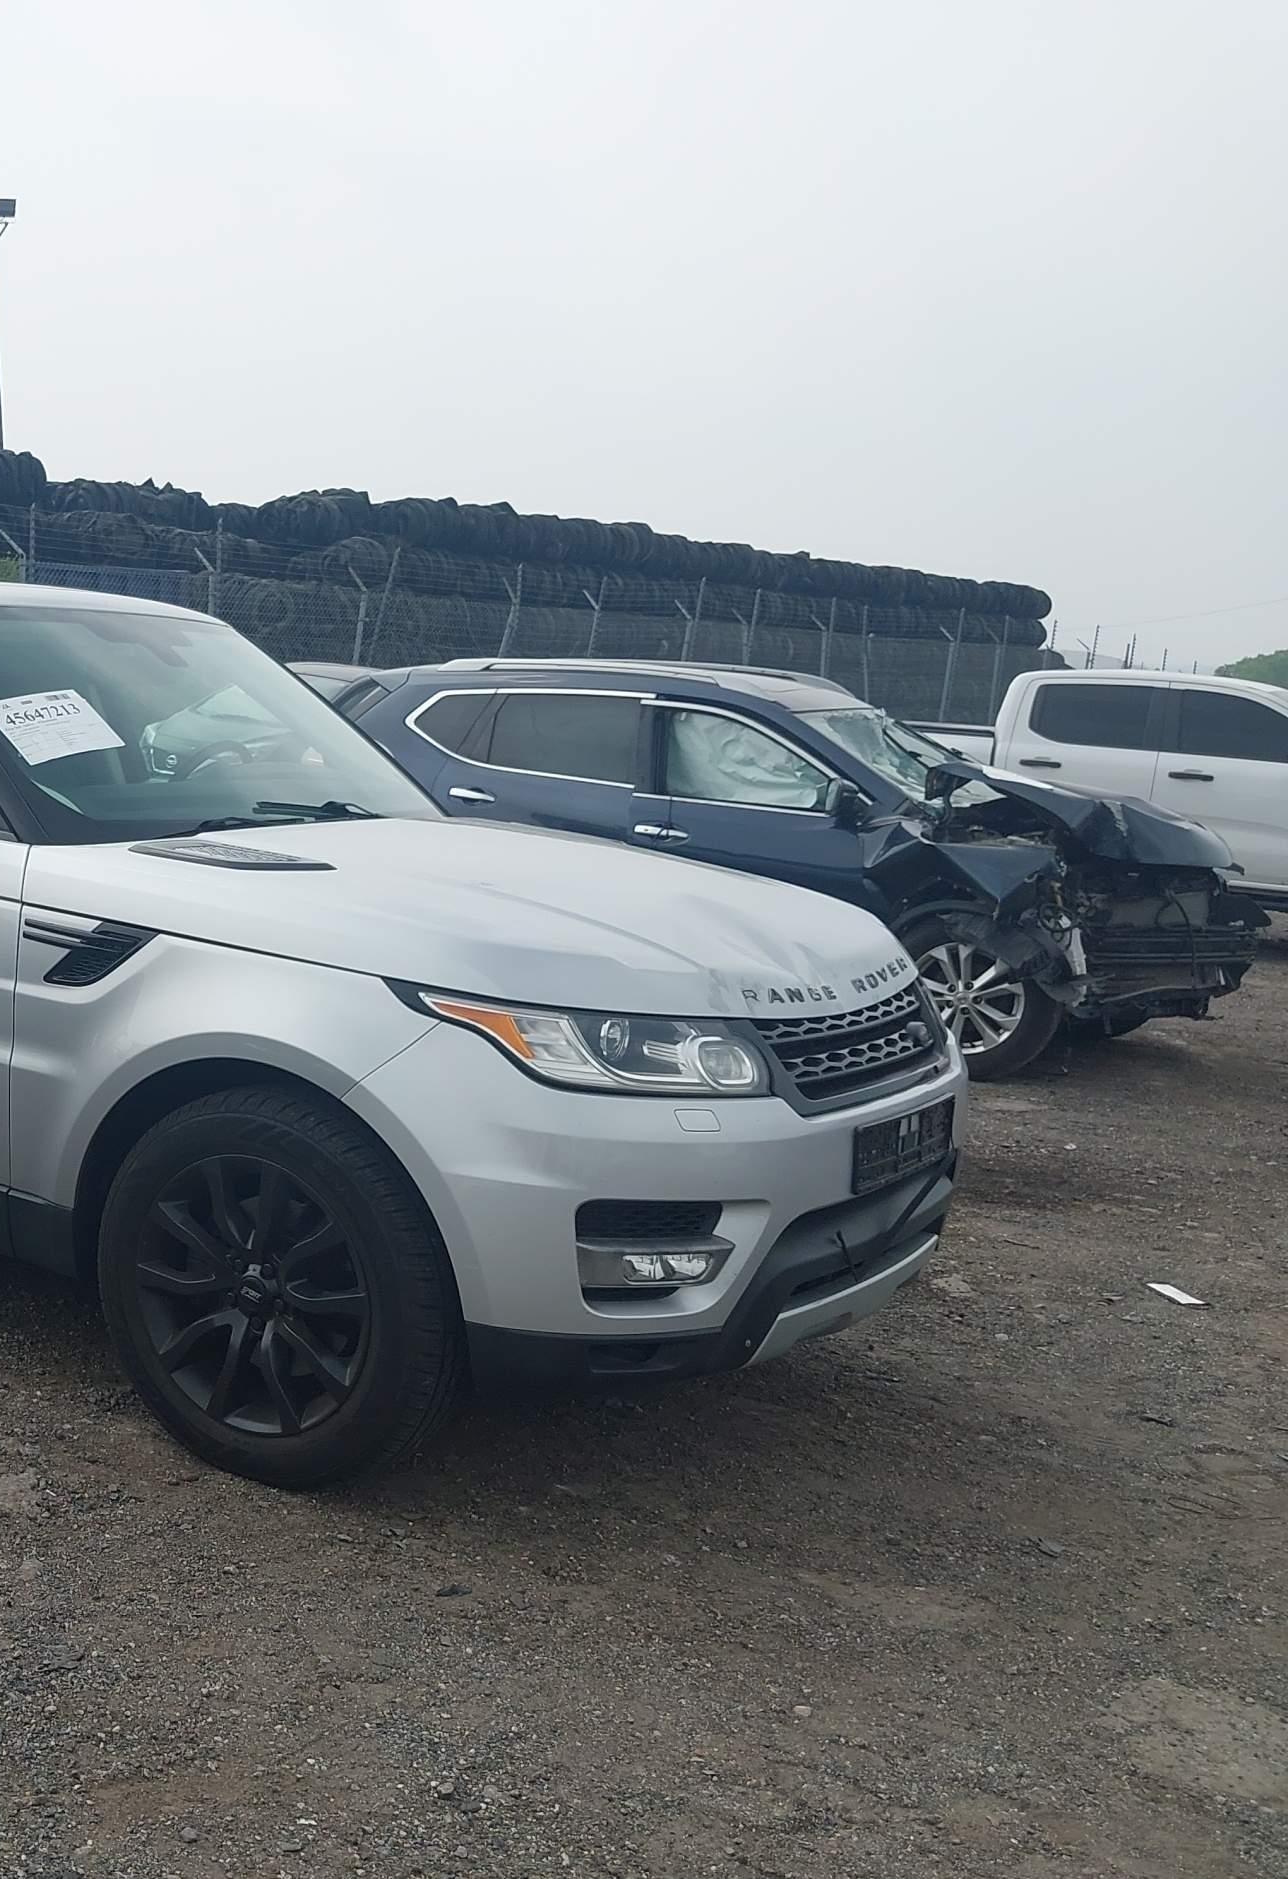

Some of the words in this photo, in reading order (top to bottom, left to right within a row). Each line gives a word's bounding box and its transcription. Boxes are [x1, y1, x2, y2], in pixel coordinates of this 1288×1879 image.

[5, 703, 81, 725] 45647213
[741, 985, 837, 1004] RANGE
[850, 957, 909, 994] ROVER
